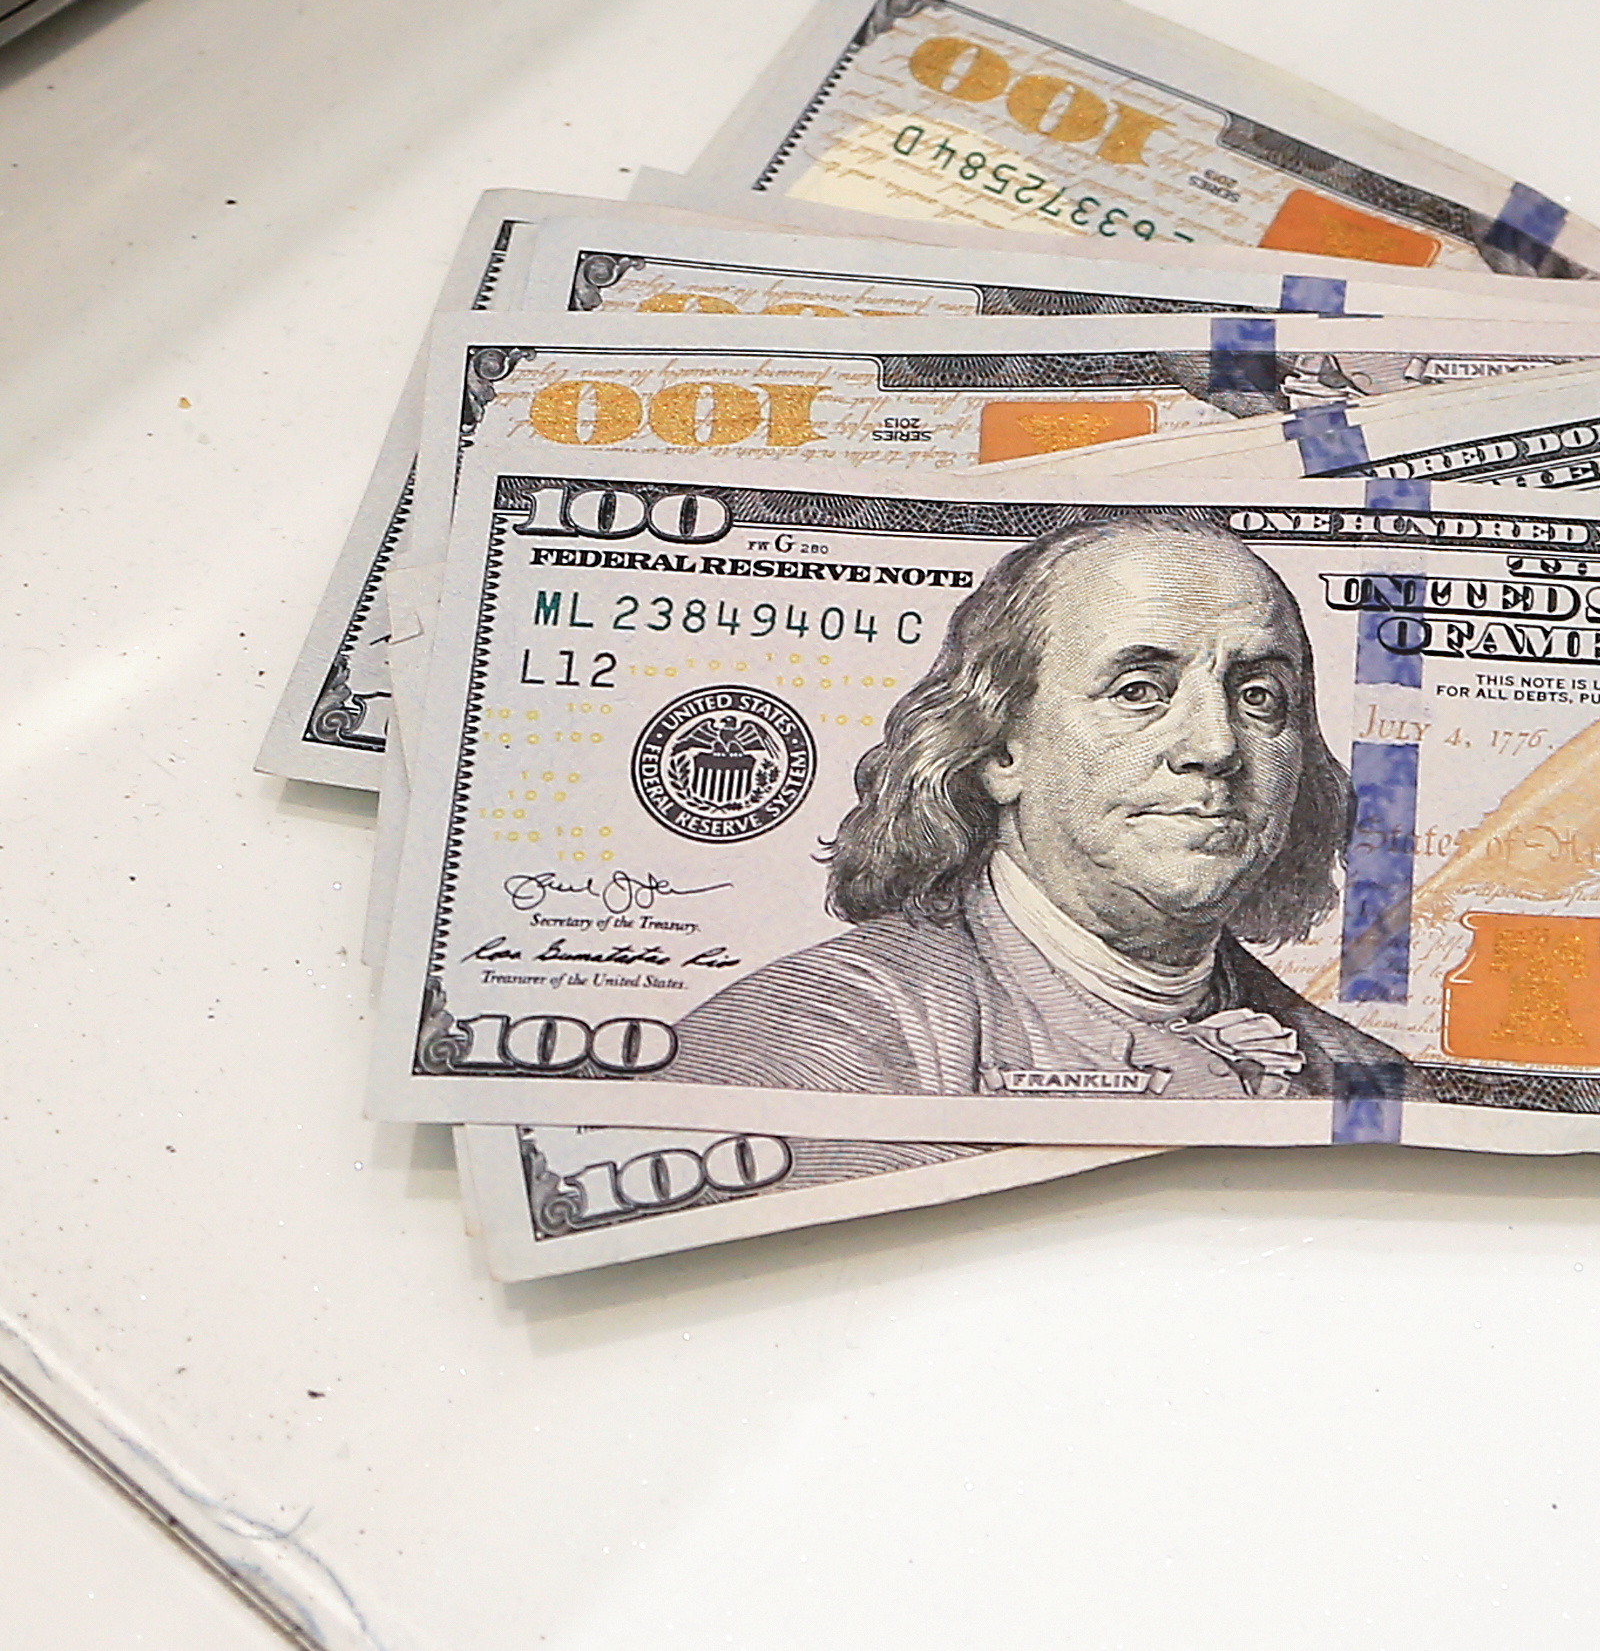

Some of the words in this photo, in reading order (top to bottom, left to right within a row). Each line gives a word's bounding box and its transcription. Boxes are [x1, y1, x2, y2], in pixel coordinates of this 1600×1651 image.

[908, 34, 1177, 169] 100
[1188, 175, 1242, 204] SERIES
[1433, 362, 1537, 378] ANKLIN
[527, 380, 833, 448] 100
[883, 416, 923, 430] 2013
[871, 430, 933, 442] SERIES
[512, 486, 734, 545] 100
[1228, 510, 1334, 535] ONE
[1341, 512, 1590, 546] HUNDRED
[773, 532, 794, 554] G
[529, 547, 698, 574] FEDERAL
[700, 556, 871, 584] RESERVE
[869, 567, 974, 589] NOTE
[534, 590, 594, 629] ML
[612, 594, 879, 644] 23849404
[896, 610, 924, 645] C
[1318, 573, 1582, 623] UNITED
[1376, 615, 1474, 658] OF
[520, 648, 618, 689] L12
[1475, 673, 1516, 687] THIS
[1520, 675, 1567, 689] NOTE
[1571, 678, 1587, 690] IS
[660, 693, 733, 731] UNITED
[738, 695, 798, 736] STATES
[1436, 684, 1470, 698] FOR
[1475, 686, 1508, 701] ALL
[1513, 689, 1575, 705] DEBTS,
[641, 743, 674, 817] FEDERAL
[673, 810, 763, 836] RESERVE
[765, 749, 808, 818] SYSTEM
[529, 912, 594, 932] Secretary
[596, 913, 611, 932] of
[612, 914, 634, 930] the
[481, 970, 548, 988] Treasurer
[549, 971, 566, 990] of
[566, 973, 589, 988] the
[592, 973, 641, 990] United
[642, 974, 689, 991] States.
[452, 1014, 679, 1074] 100
[1011, 1071, 1140, 1091] FRANKLIN
[563, 1133, 797, 1220] 100
